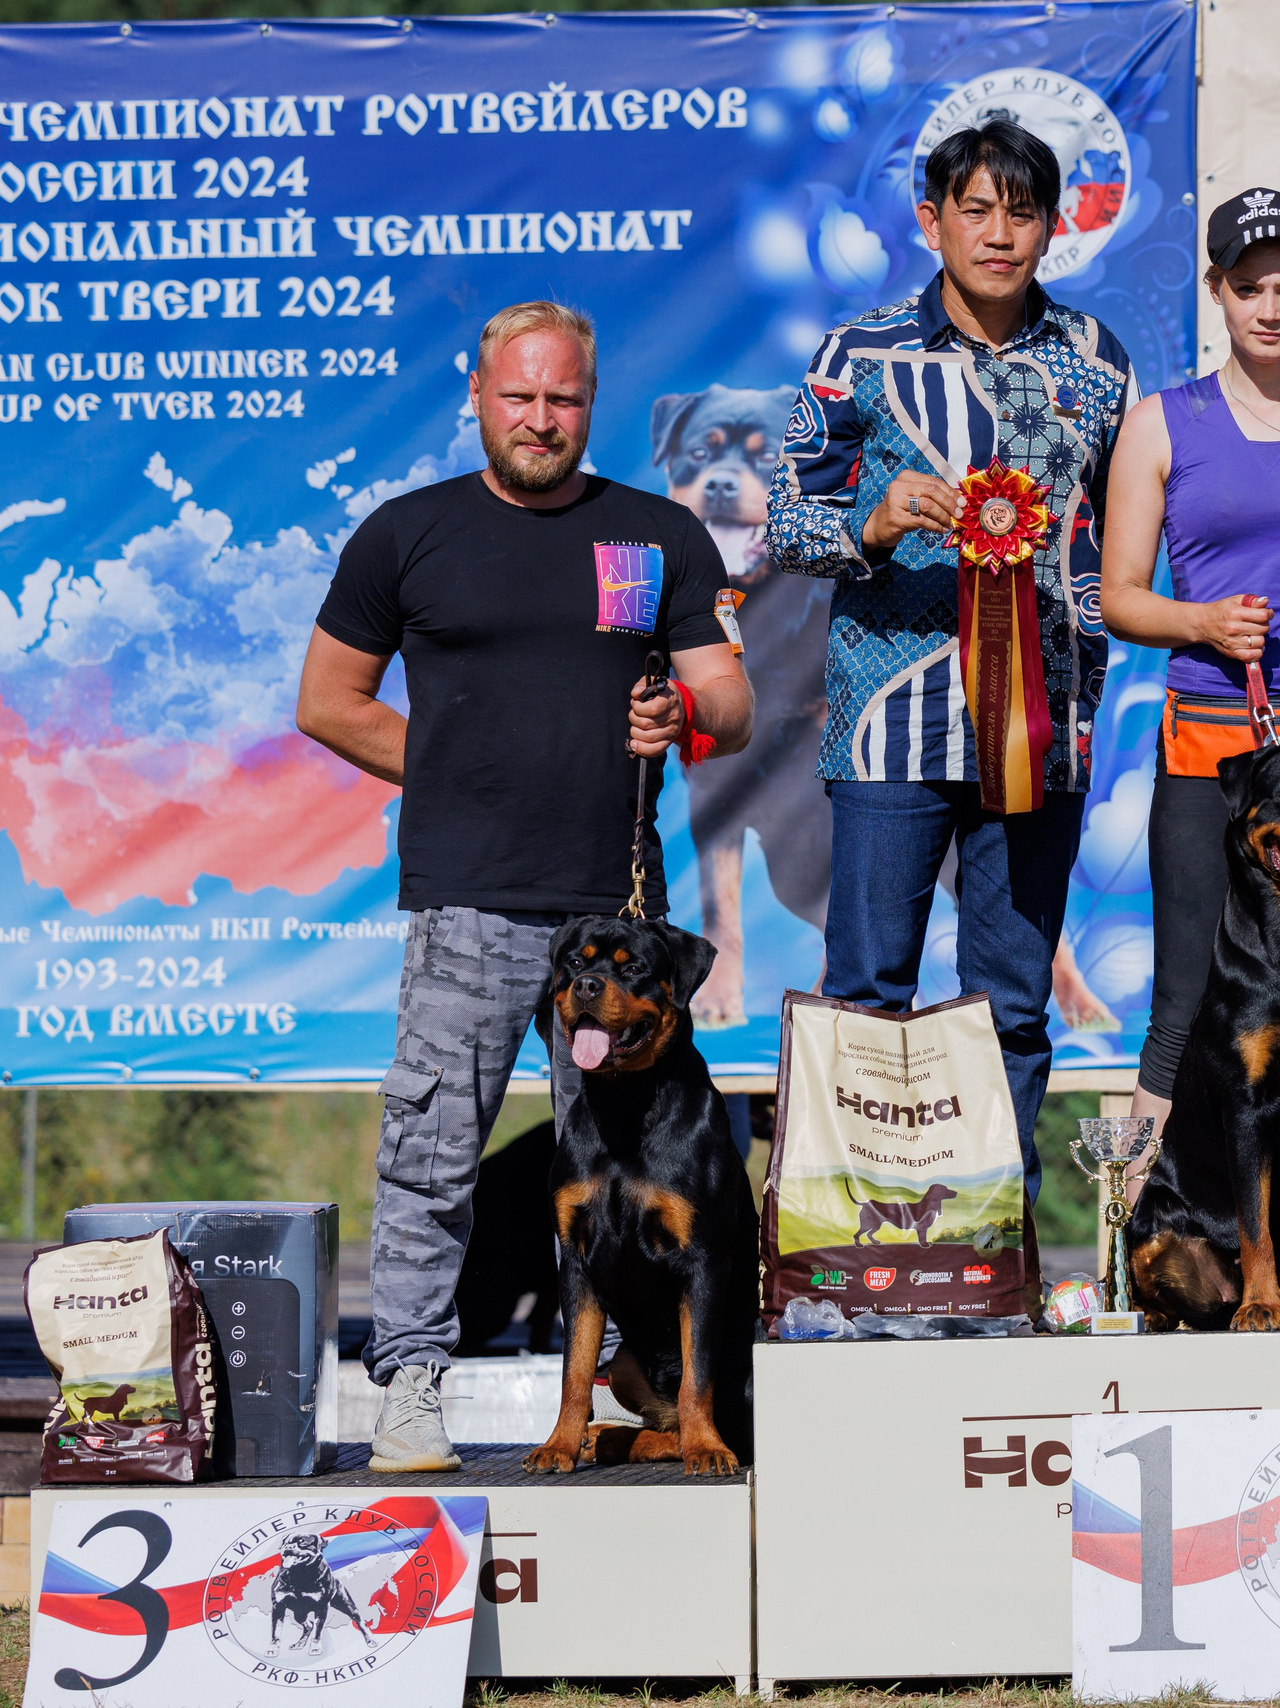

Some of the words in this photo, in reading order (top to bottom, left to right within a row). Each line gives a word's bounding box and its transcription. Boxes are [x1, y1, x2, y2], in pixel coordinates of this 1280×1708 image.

[1012, 76, 1084, 108] КЛУБ
[0, 94, 345, 142] ЧЕМПИОНАТ
[362, 81, 748, 137] РОТВЕЙЛЕРОВ
[192, 155, 309, 199] 2024
[333, 208, 693, 257] ЧЕМПИОНАТ
[79, 278, 261, 322] ТВЕРИ
[278, 275, 396, 318] 2024
[45, 351, 144, 382] CLUB
[156, 349, 309, 380] WINNER
[320, 347, 398, 377] 2024
[54, 392, 102, 423] OF
[113, 390, 215, 421] TVER
[227, 389, 305, 419] 2024
[595, 624, 612, 633] NIKE
[41, 919, 200, 944] Чемпионаты
[210, 917, 270, 941] НКП
[35, 956, 227, 991] 1993-2024
[16, 1004, 95, 1044] ГОД
[108, 1002, 298, 1037] ВМЕСТЕ
[836, 1085, 962, 1129] Hanta
[872, 1126, 923, 1142] premium
[848, 1143, 955, 1168] SMALL/MEDIUM
[214, 1254, 283, 1277] Stark
[869, 1271, 890, 1279] FRESH
[53, 1285, 149, 1310] Hanta
[869, 1278, 887, 1287] MEAT
[82, 1310, 122, 1319] premium
[62, 1330, 138, 1350] SMALL/MEDIUM
[1104, 1424, 1206, 1653] 1
[206, 1510, 308, 1641] РОТВЕЙЛЕР
[325, 1507, 398, 1537] КЛУБ
[403, 1540, 436, 1638] РОССИИ
[54, 1509, 173, 1691] 3
[252, 1653, 379, 1685] РКФ-НКПР
